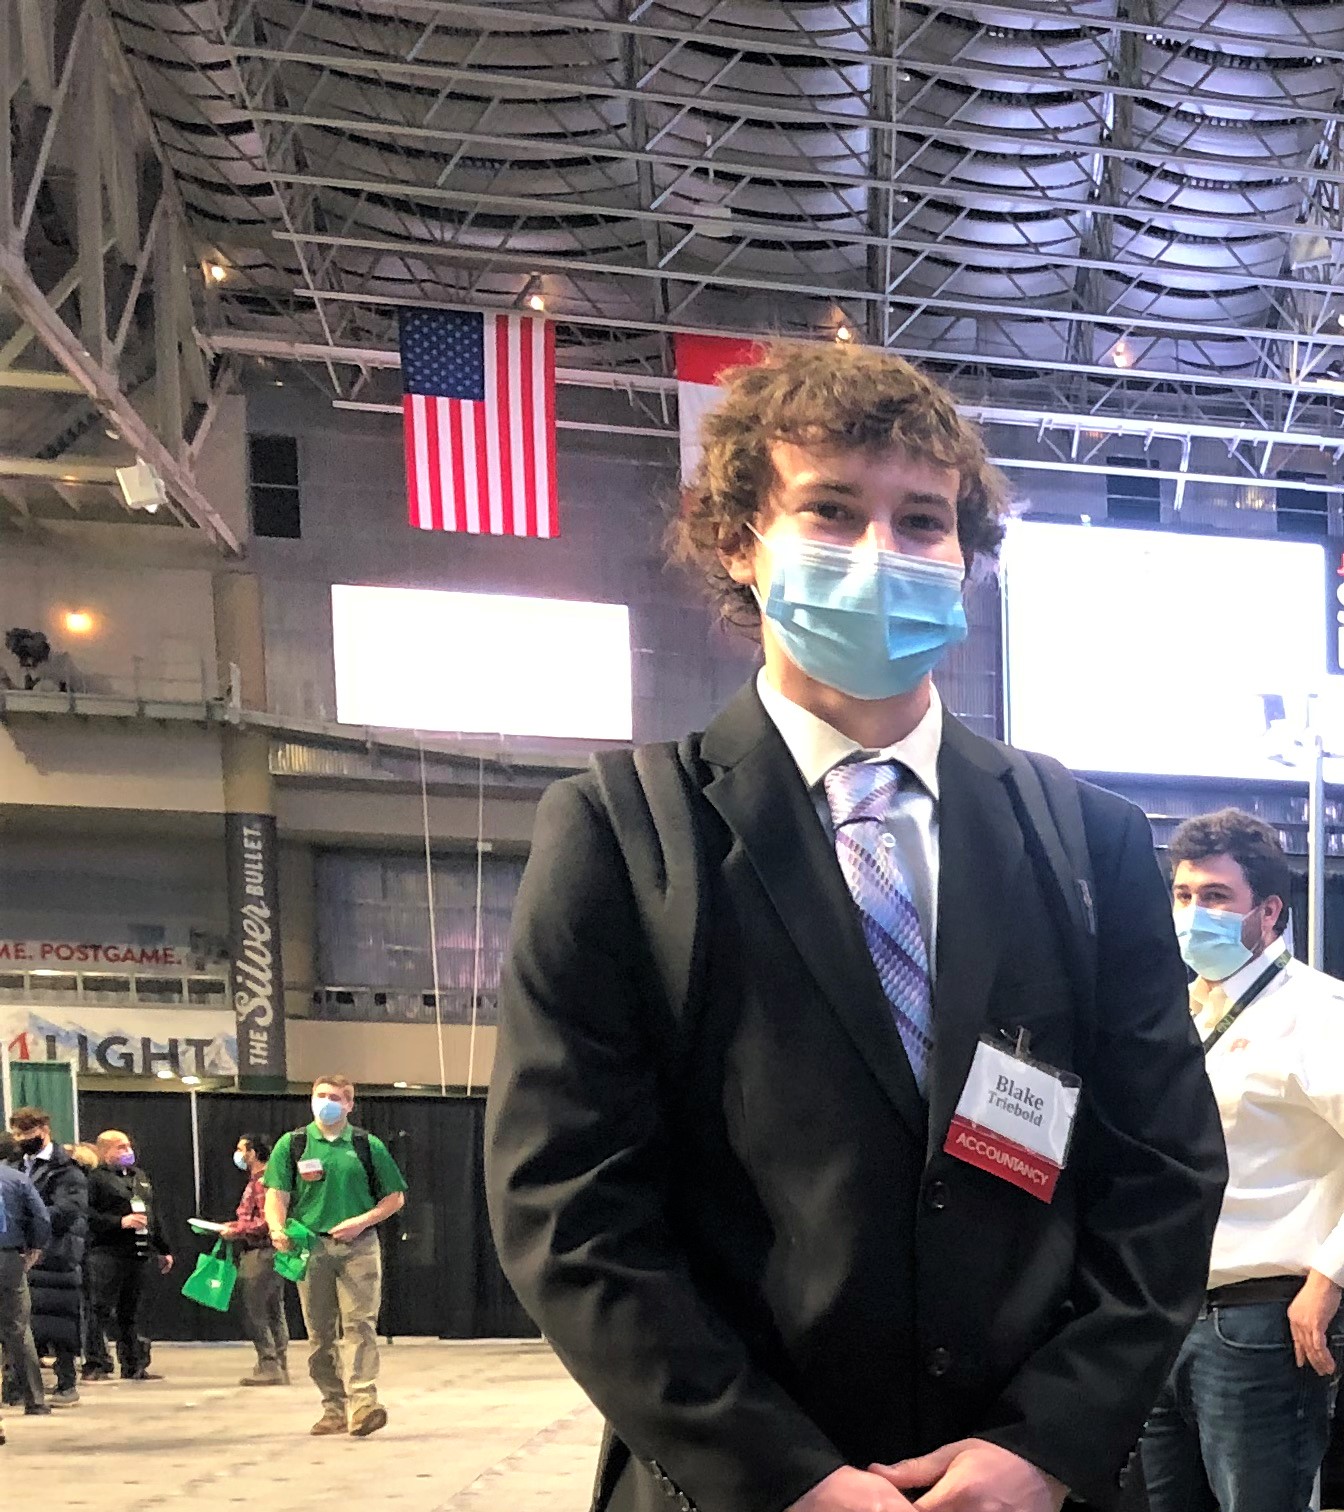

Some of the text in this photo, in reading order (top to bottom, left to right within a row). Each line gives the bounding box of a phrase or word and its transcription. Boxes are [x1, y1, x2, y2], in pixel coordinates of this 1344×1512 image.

[41, 943, 182, 964] POSTGAME.
[235, 826, 273, 1066] THE Silver BULLET
[988, 1090, 1043, 1127] Triebold
[996, 1075, 1044, 1111] Blake
[956, 1132, 1048, 1185] ACCOUNTANCY
